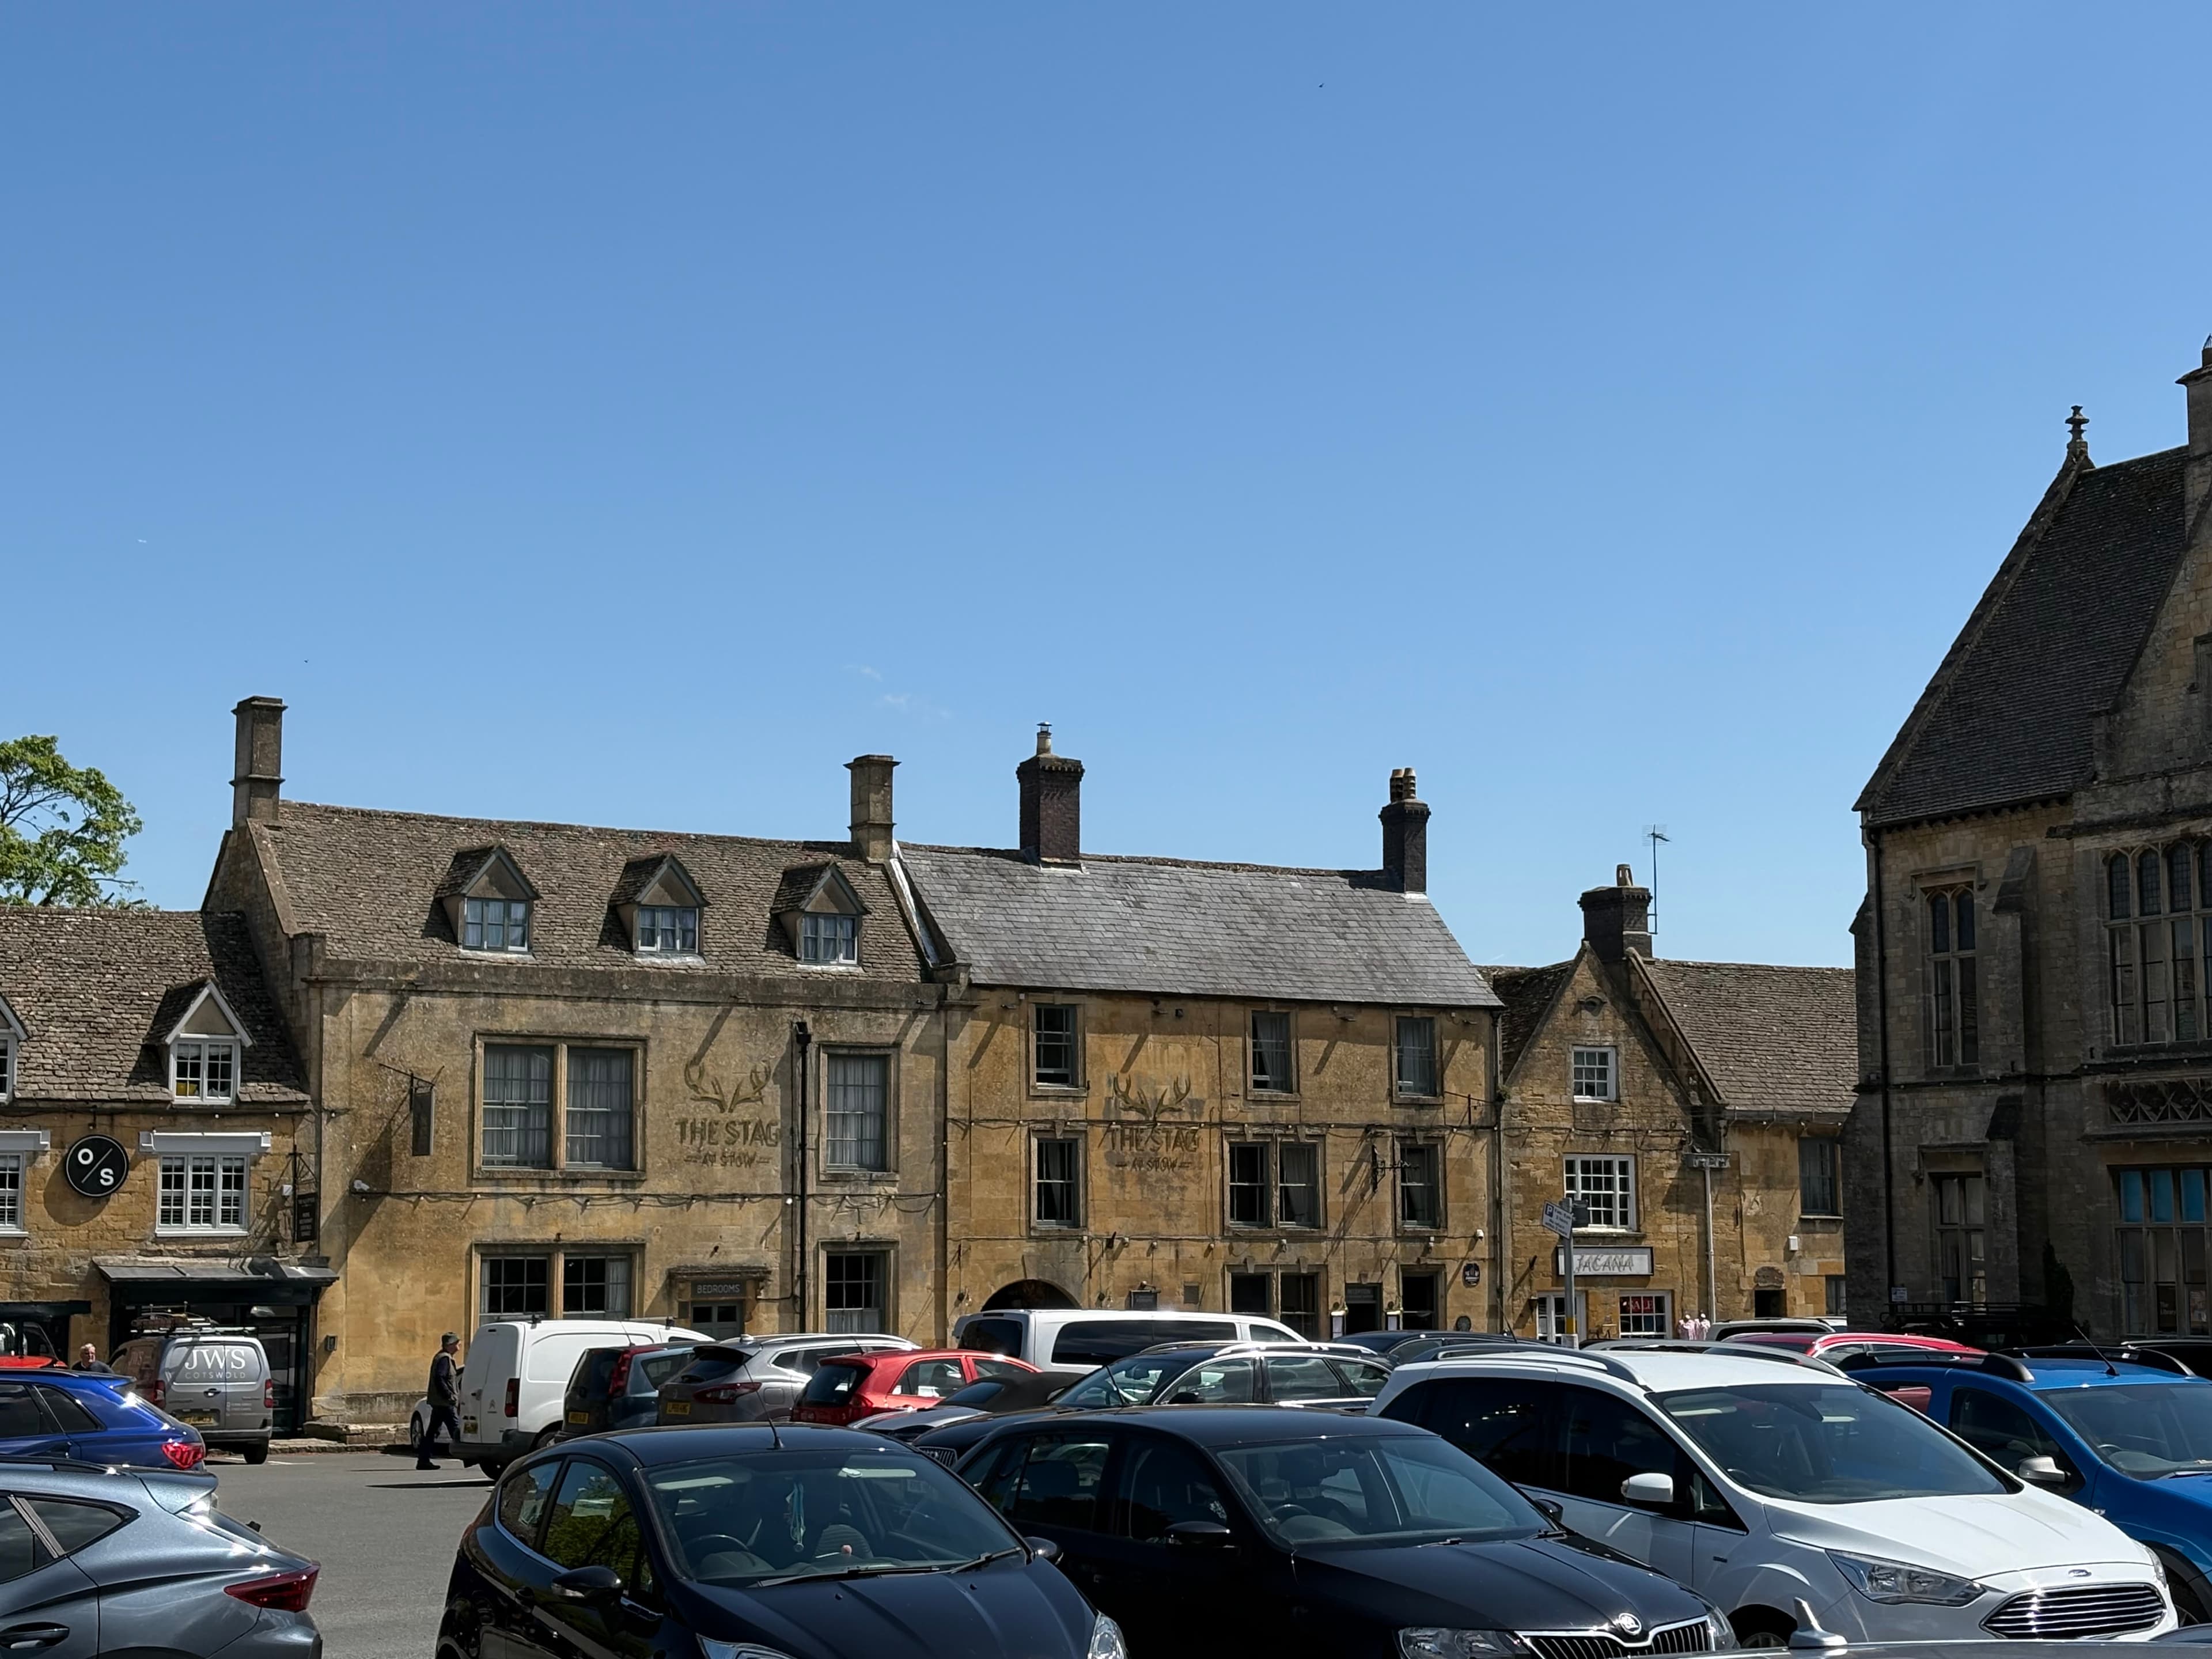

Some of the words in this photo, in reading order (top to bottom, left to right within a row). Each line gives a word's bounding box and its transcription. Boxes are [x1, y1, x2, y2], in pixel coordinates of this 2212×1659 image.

[675, 1118, 719, 1145] THE
[725, 1119, 781, 1147] STAG
[1107, 1127, 1145, 1152] THE
[1149, 1127, 1200, 1152] STAG
[702, 1153, 716, 1166] AT
[720, 1152, 757, 1168] STOW
[1146, 1157, 1178, 1172] STOW
[1575, 1253, 1634, 1272] JACANA
[697, 1284, 740, 1294] BEDROOMS
[1628, 1300, 1653, 1309] SALE
[184, 1349, 246, 1370] JWS
